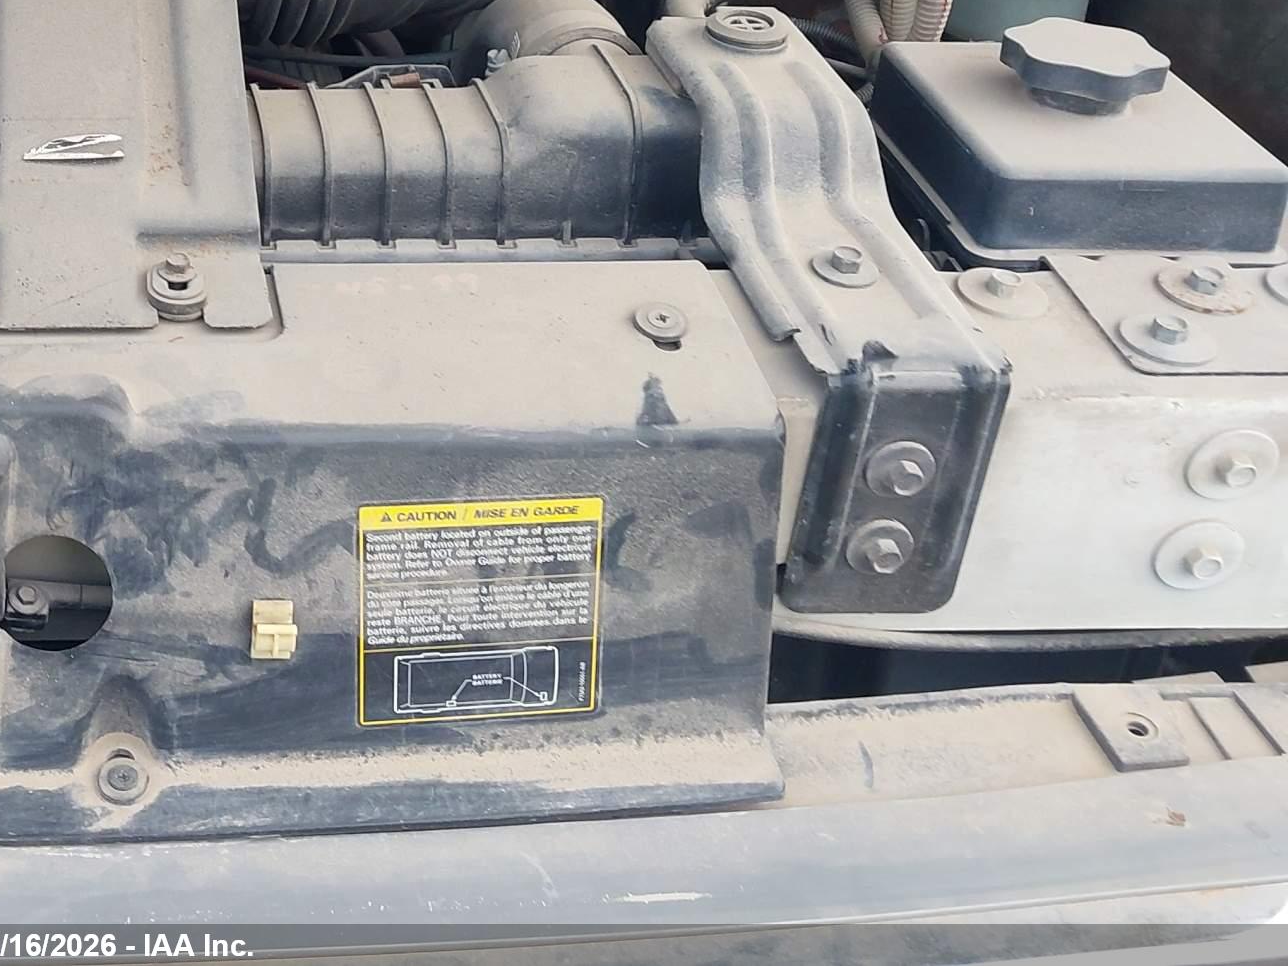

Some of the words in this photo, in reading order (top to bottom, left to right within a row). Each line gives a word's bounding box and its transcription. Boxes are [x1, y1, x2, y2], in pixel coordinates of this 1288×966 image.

[397, 511, 456, 522] CAUTION
[473, 508, 506, 520] MISE
[511, 508, 527, 518] EN
[534, 506, 580, 517] GARDE
[404, 532, 438, 541] battery
[531, 526, 542, 535] of
[366, 542, 398, 552] frame
[424, 540, 470, 548] Removal
[472, 538, 484, 547] of
[486, 536, 515, 546] cable
[517, 536, 543, 544] from
[546, 535, 569, 544] only
[366, 552, 401, 562] battery
[404, 550, 428, 560] does
[431, 549, 453, 559] NOT
[456, 546, 508, 558] disconnect
[432, 560, 443, 568] to
[478, 556, 506, 566] Guide
[508, 554, 522, 564] for
[524, 554, 555, 564] proper
[552, 618, 577, 626] dans
[578, 616, 588, 624] le
[367, 636, 396, 644] Guide
[396, 634, 410, 644] du
